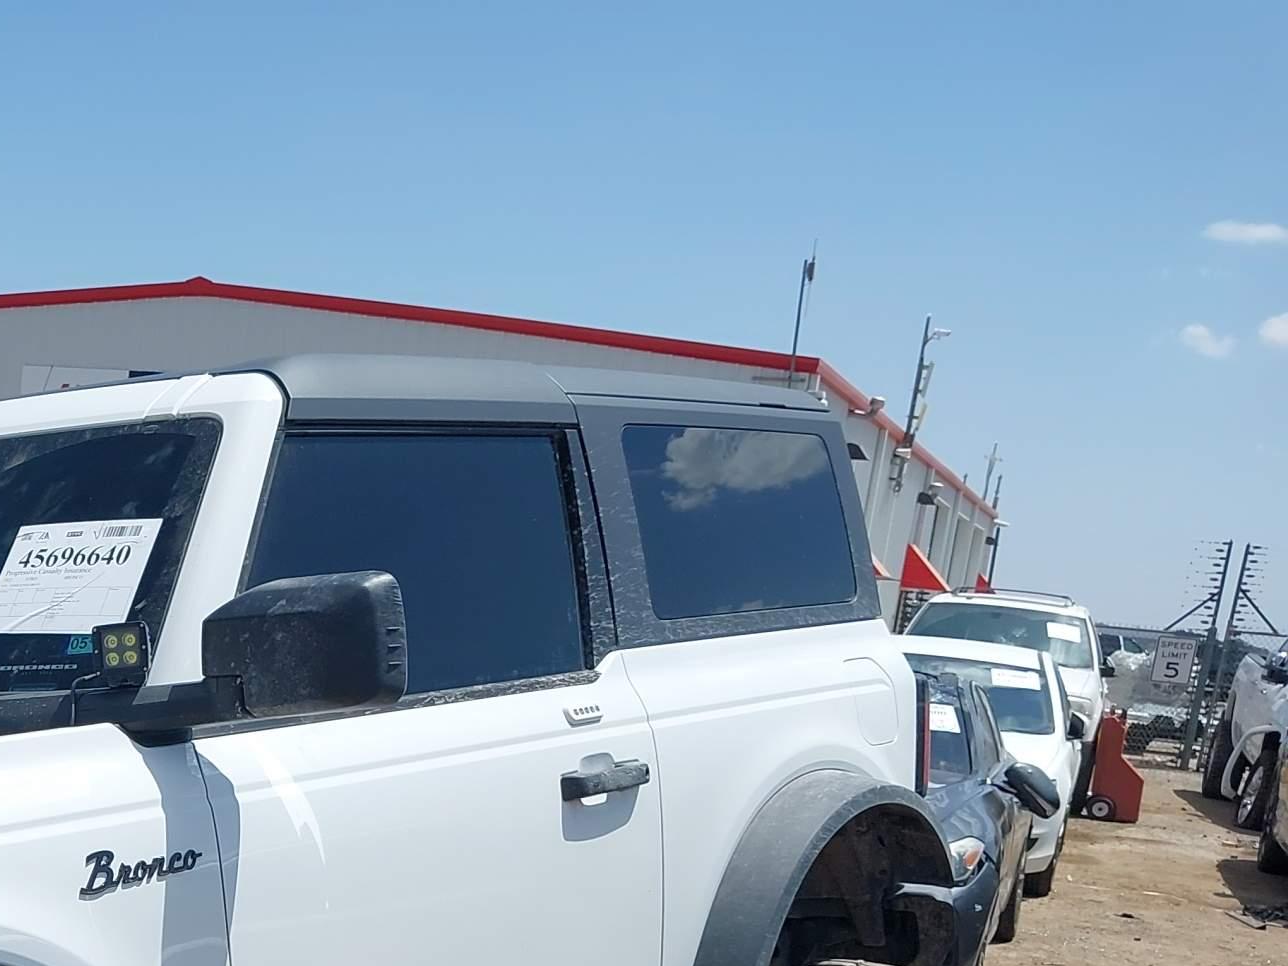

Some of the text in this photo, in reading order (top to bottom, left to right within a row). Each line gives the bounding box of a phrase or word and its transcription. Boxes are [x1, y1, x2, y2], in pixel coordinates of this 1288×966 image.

[19, 545, 131, 568] 45696640
[1160, 640, 1193, 649] SPEED
[1162, 651, 1188, 659] LIMIT
[1163, 662, 1179, 678] 5
[79, 849, 203, 900] Bronco
